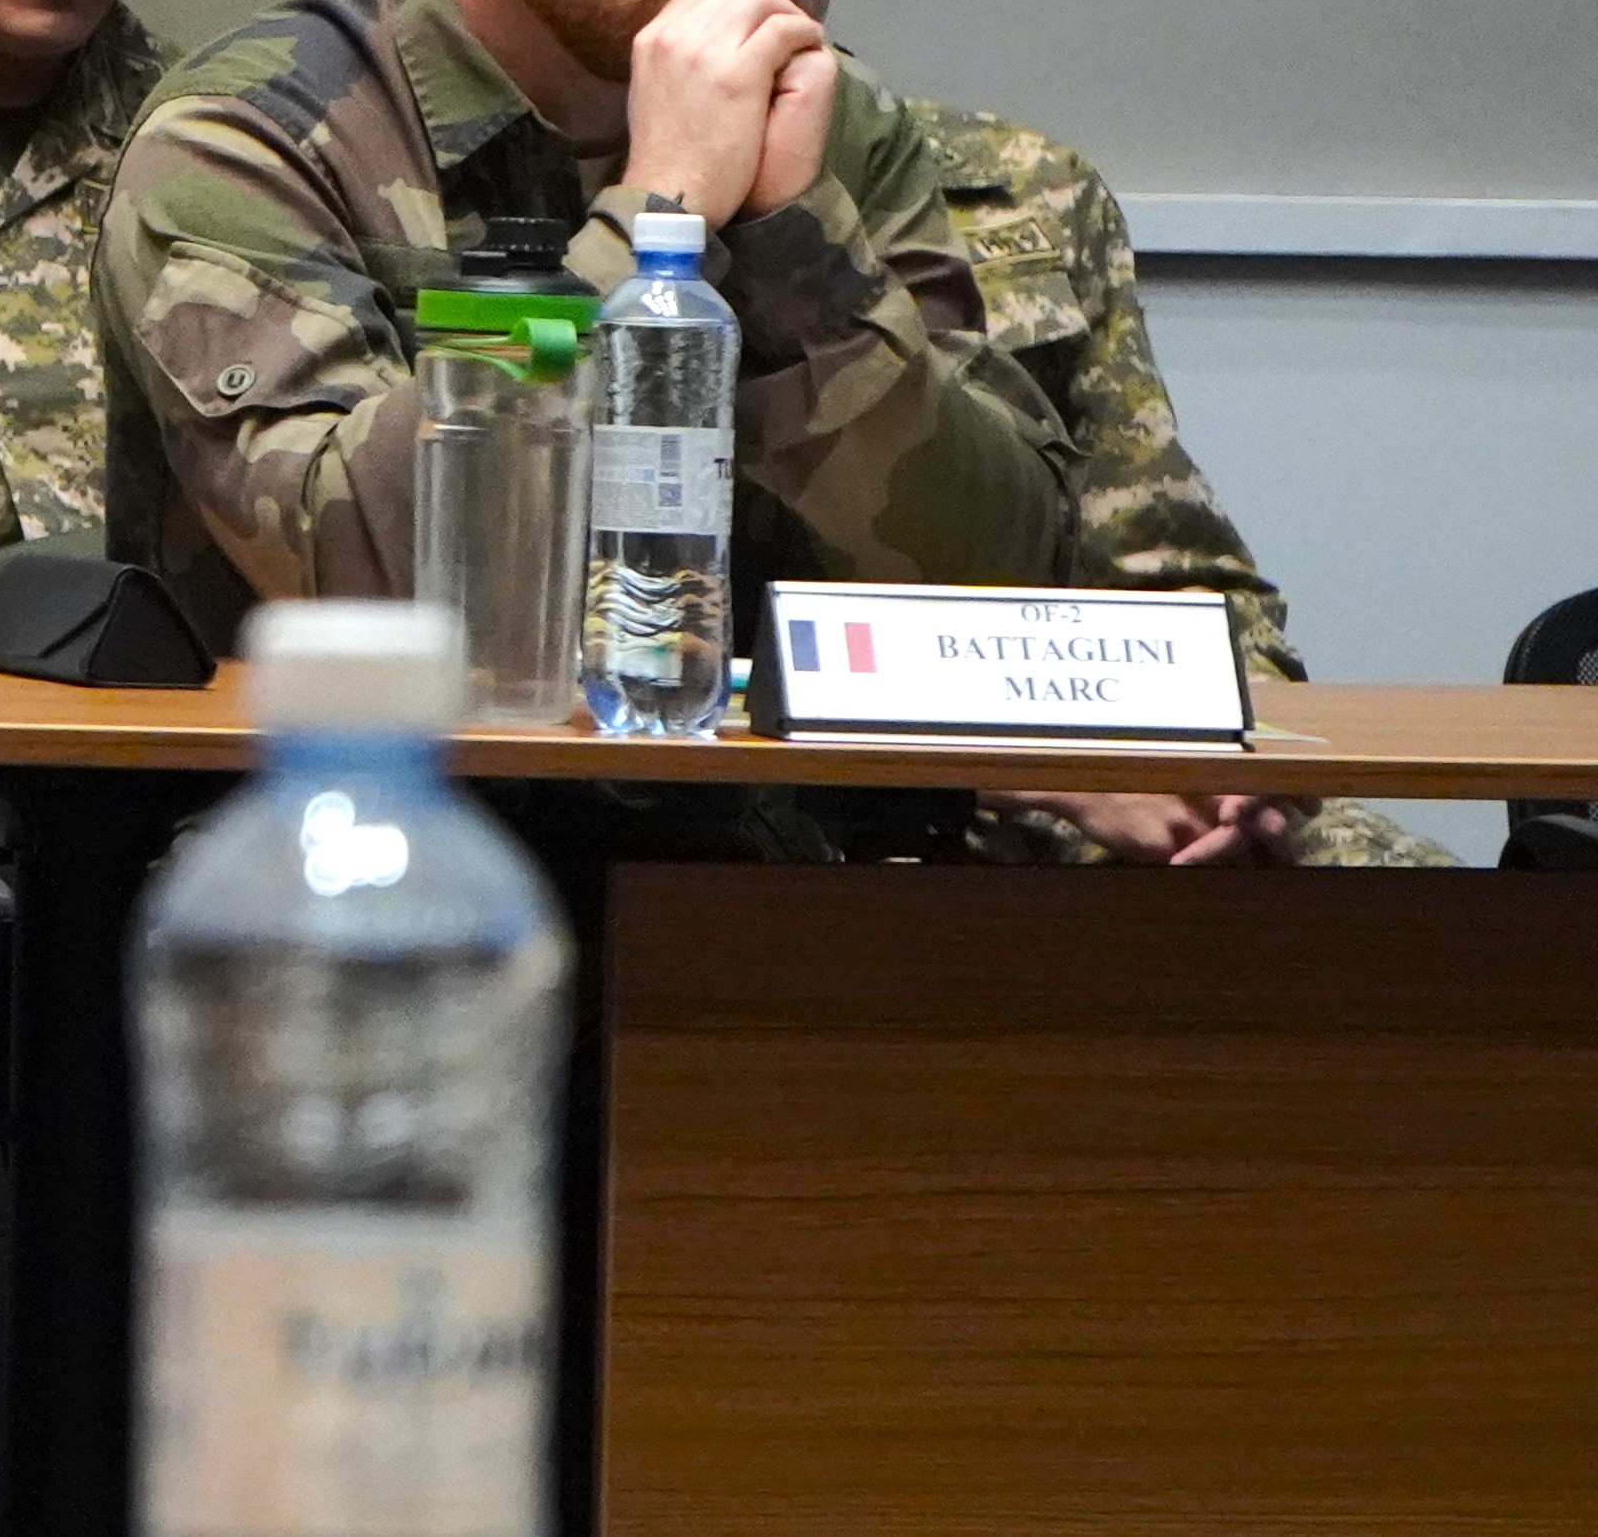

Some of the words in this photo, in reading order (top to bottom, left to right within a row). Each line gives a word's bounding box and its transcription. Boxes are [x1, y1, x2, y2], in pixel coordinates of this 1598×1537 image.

[1020, 603, 1083, 624] OF-2
[936, 634, 1177, 665] BATTAGLINI
[1004, 676, 1121, 703] MARC
